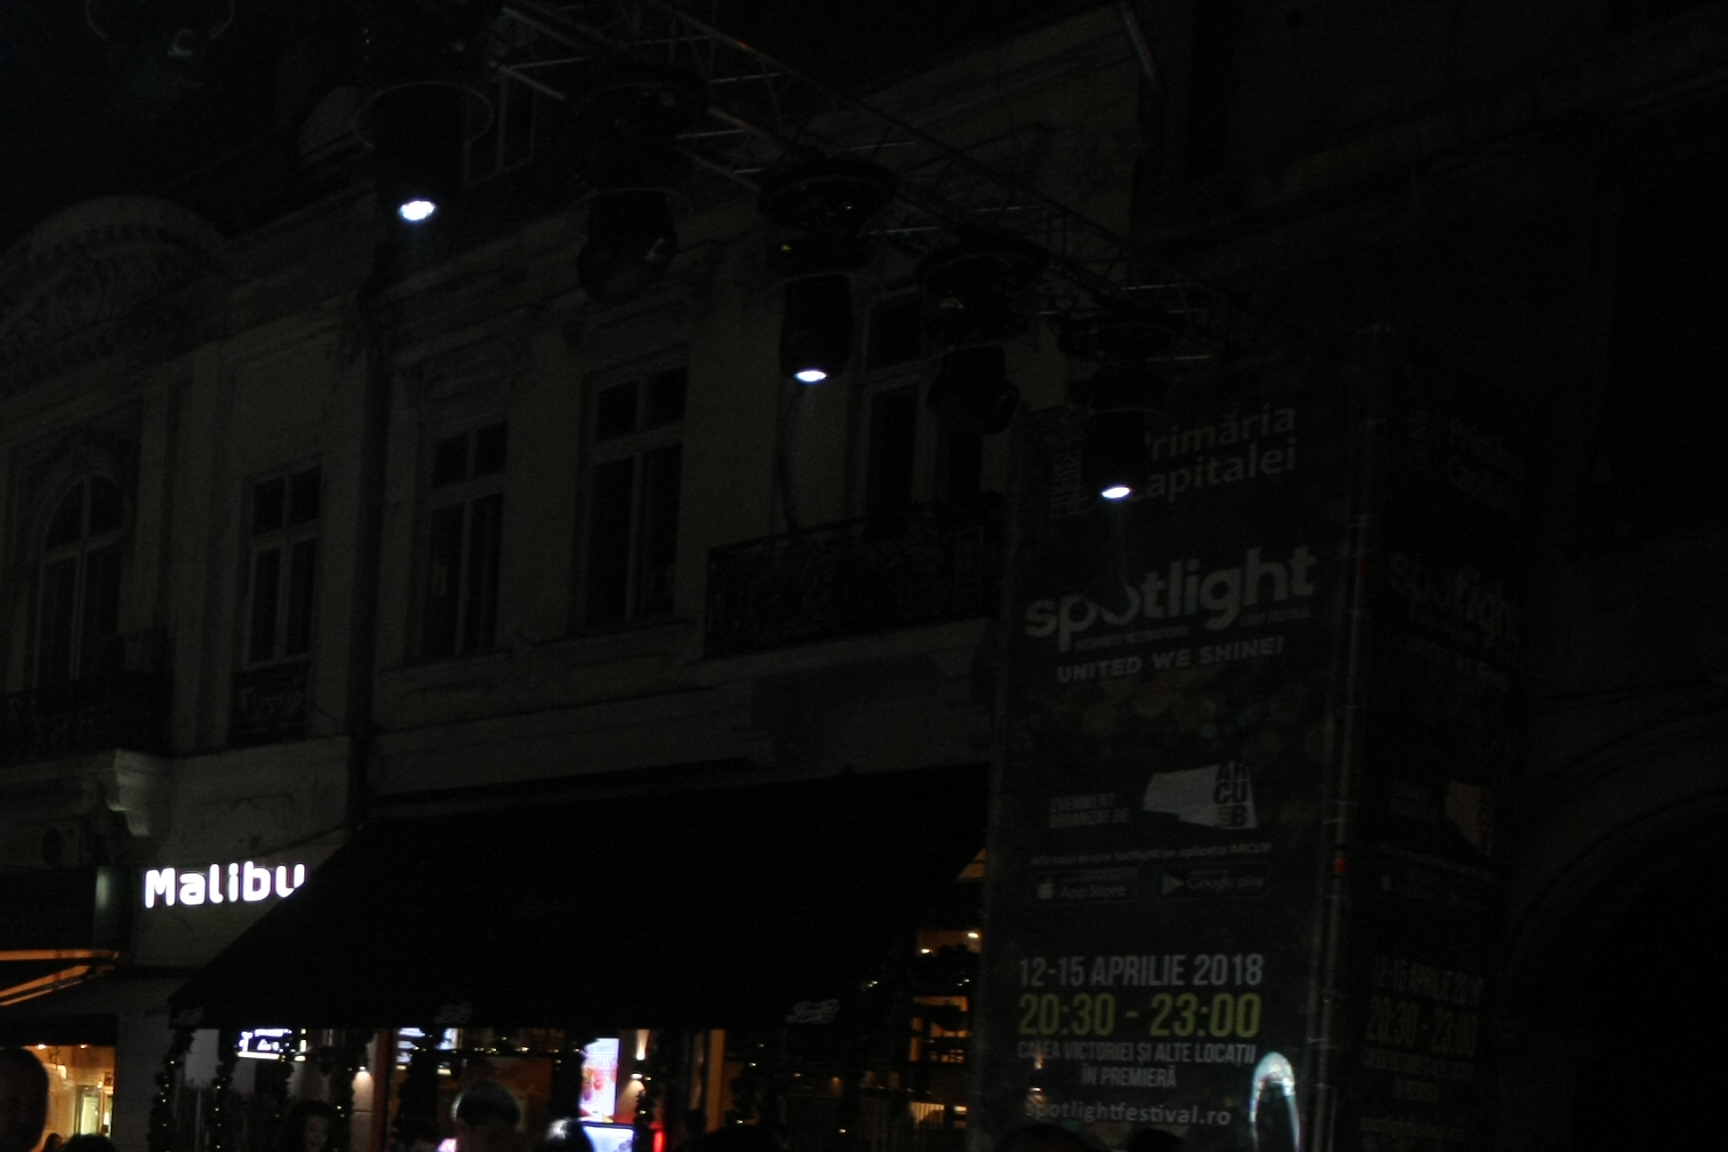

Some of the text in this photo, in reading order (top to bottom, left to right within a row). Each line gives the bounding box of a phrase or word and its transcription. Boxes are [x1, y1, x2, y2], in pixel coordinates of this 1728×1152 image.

[1145, 401, 1298, 462] rimăria
[1136, 436, 1298, 504] apitalei
[1023, 545, 1320, 654] spotlight
[1056, 656, 1143, 684] UNITED
[1152, 648, 1192, 671] WE
[1198, 634, 1285, 666] SHINE!
[144, 860, 306, 909] Malibu
[1019, 952, 1266, 988] 12-15 APRILIE 2018
[1017, 991, 1118, 1037] 20:30
[1149, 991, 1264, 1039] 23:00
